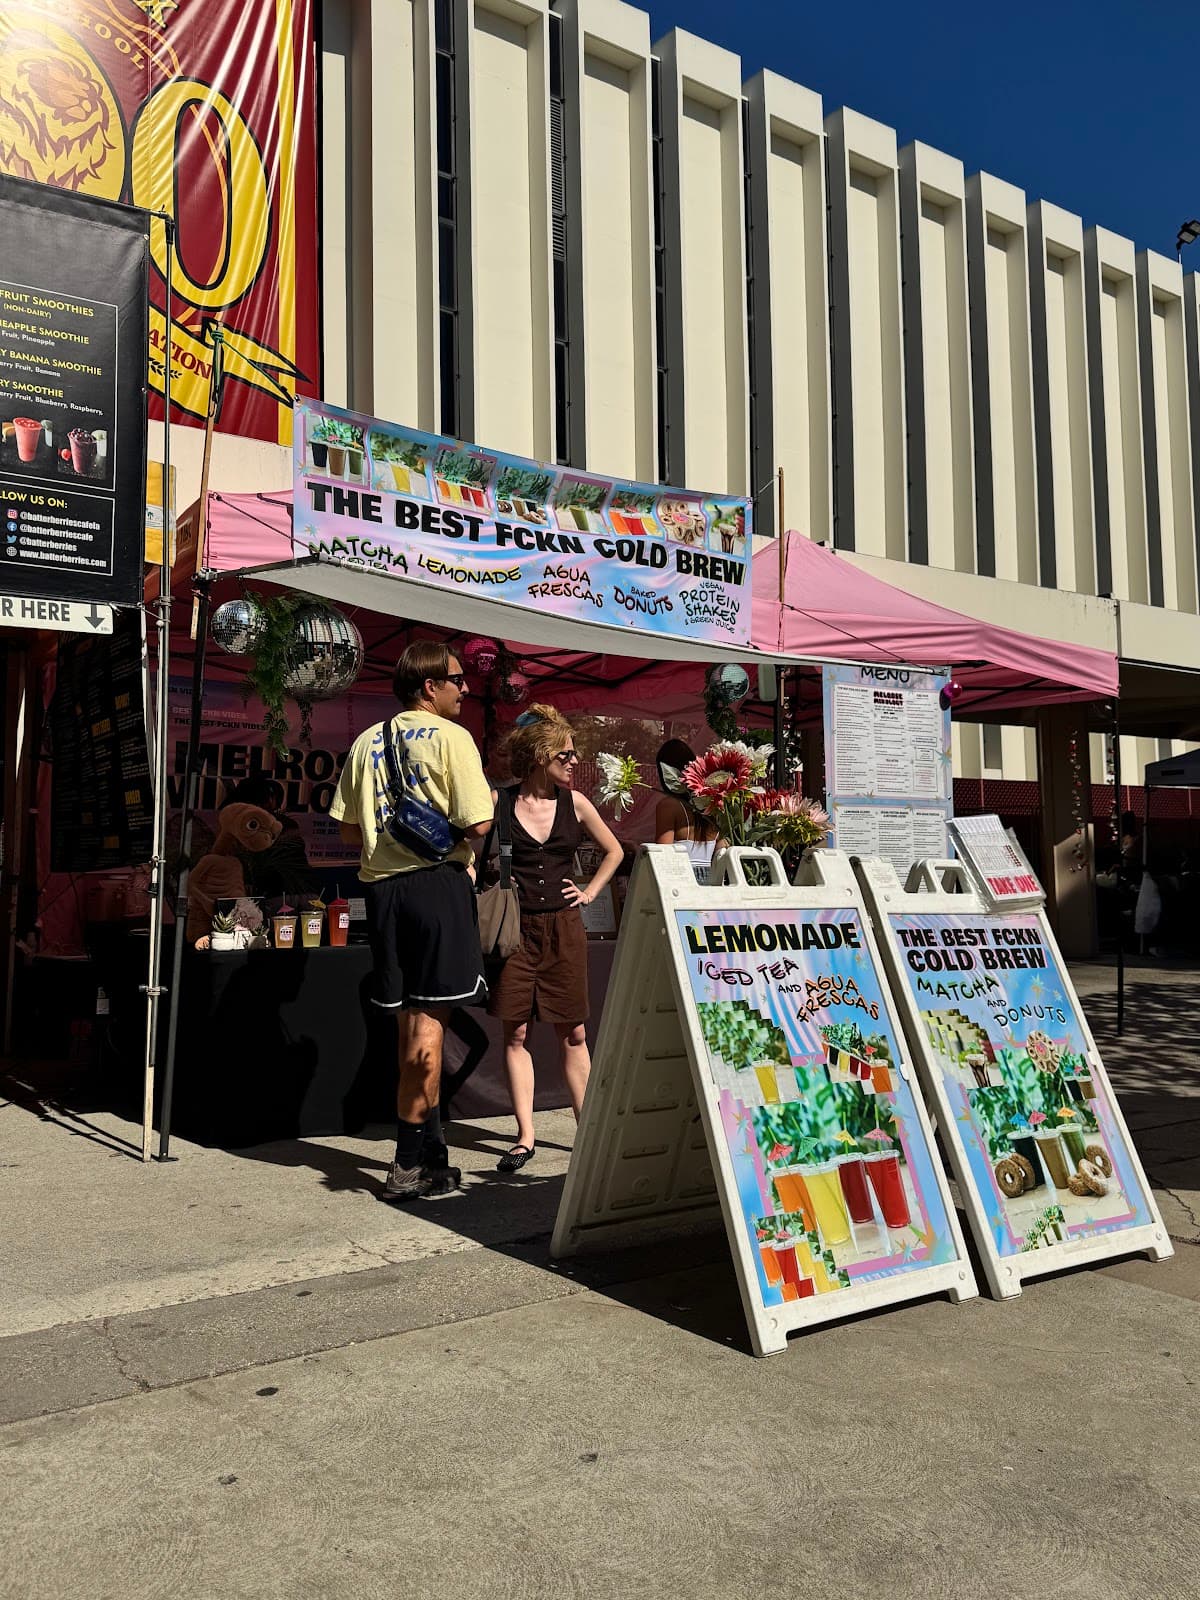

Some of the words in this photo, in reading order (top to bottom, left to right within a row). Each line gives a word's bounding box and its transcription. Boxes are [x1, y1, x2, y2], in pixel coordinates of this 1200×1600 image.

[0, 289, 30, 303] FRUIT
[33, 296, 94, 317] SMOOTHIES
[3, 303, 52, 319] (NON-DAIRY)
[1, 330, 20, 340] Fruit,
[22, 334, 55, 347] Pineapple
[39, 328, 89, 345] SMOOTHIE
[10, 351, 50, 366] BANANA
[52, 359, 102, 376] SMOOTHIE
[15, 363, 33, 373] Fruit,
[12, 381, 64, 398] SMOOTHIE
[15, 392, 33, 402] Fruit,
[30, 494, 44, 505] US
[47, 498, 68, 509] ON:
[20, 523, 94, 542] @batterberriescafe
[308, 482, 383, 524] THE
[395, 499, 484, 542] BEST
[494, 521, 585, 554] FCKN
[593, 539, 669, 568] COLD
[676, 549, 747, 586] BREW
[19, 536, 78, 552] @batterberries
[19, 549, 107, 568] www.batterberries.com
[309, 536, 408, 574] MATCHA
[418, 554, 522, 585] LEMONADE
[543, 565, 591, 586] AGUA
[528, 583, 603, 608] FRESCAS
[630, 587, 656, 598] BAKED
[700, 581, 724, 592] VEGAN
[21, 600, 71, 622] HERE
[614, 586, 673, 615] DONUTS
[679, 589, 740, 613] PROTEIN
[686, 603, 737, 625] SHAKES
[716, 619, 735, 634] JUICE
[861, 666, 910, 683] MENU
[987, 877, 1017, 895] TAKE
[1014, 874, 1041, 892] ONE
[685, 923, 862, 954] LEMONADE
[897, 929, 937, 947] THE
[940, 928, 988, 946] BEST
[992, 928, 1042, 946] FCKN
[907, 949, 975, 973] COLD
[981, 947, 1048, 970] BREW
[698, 959, 753, 985] ICED
[757, 957, 800, 984] TEA
[778, 984, 801, 994] AND
[804, 975, 858, 996] AGUA
[917, 974, 1000, 1001] MATCHA
[797, 990, 879, 1023] FRESCAS
[987, 999, 1007, 1008] AND
[993, 1004, 1067, 1028] DONUTS
